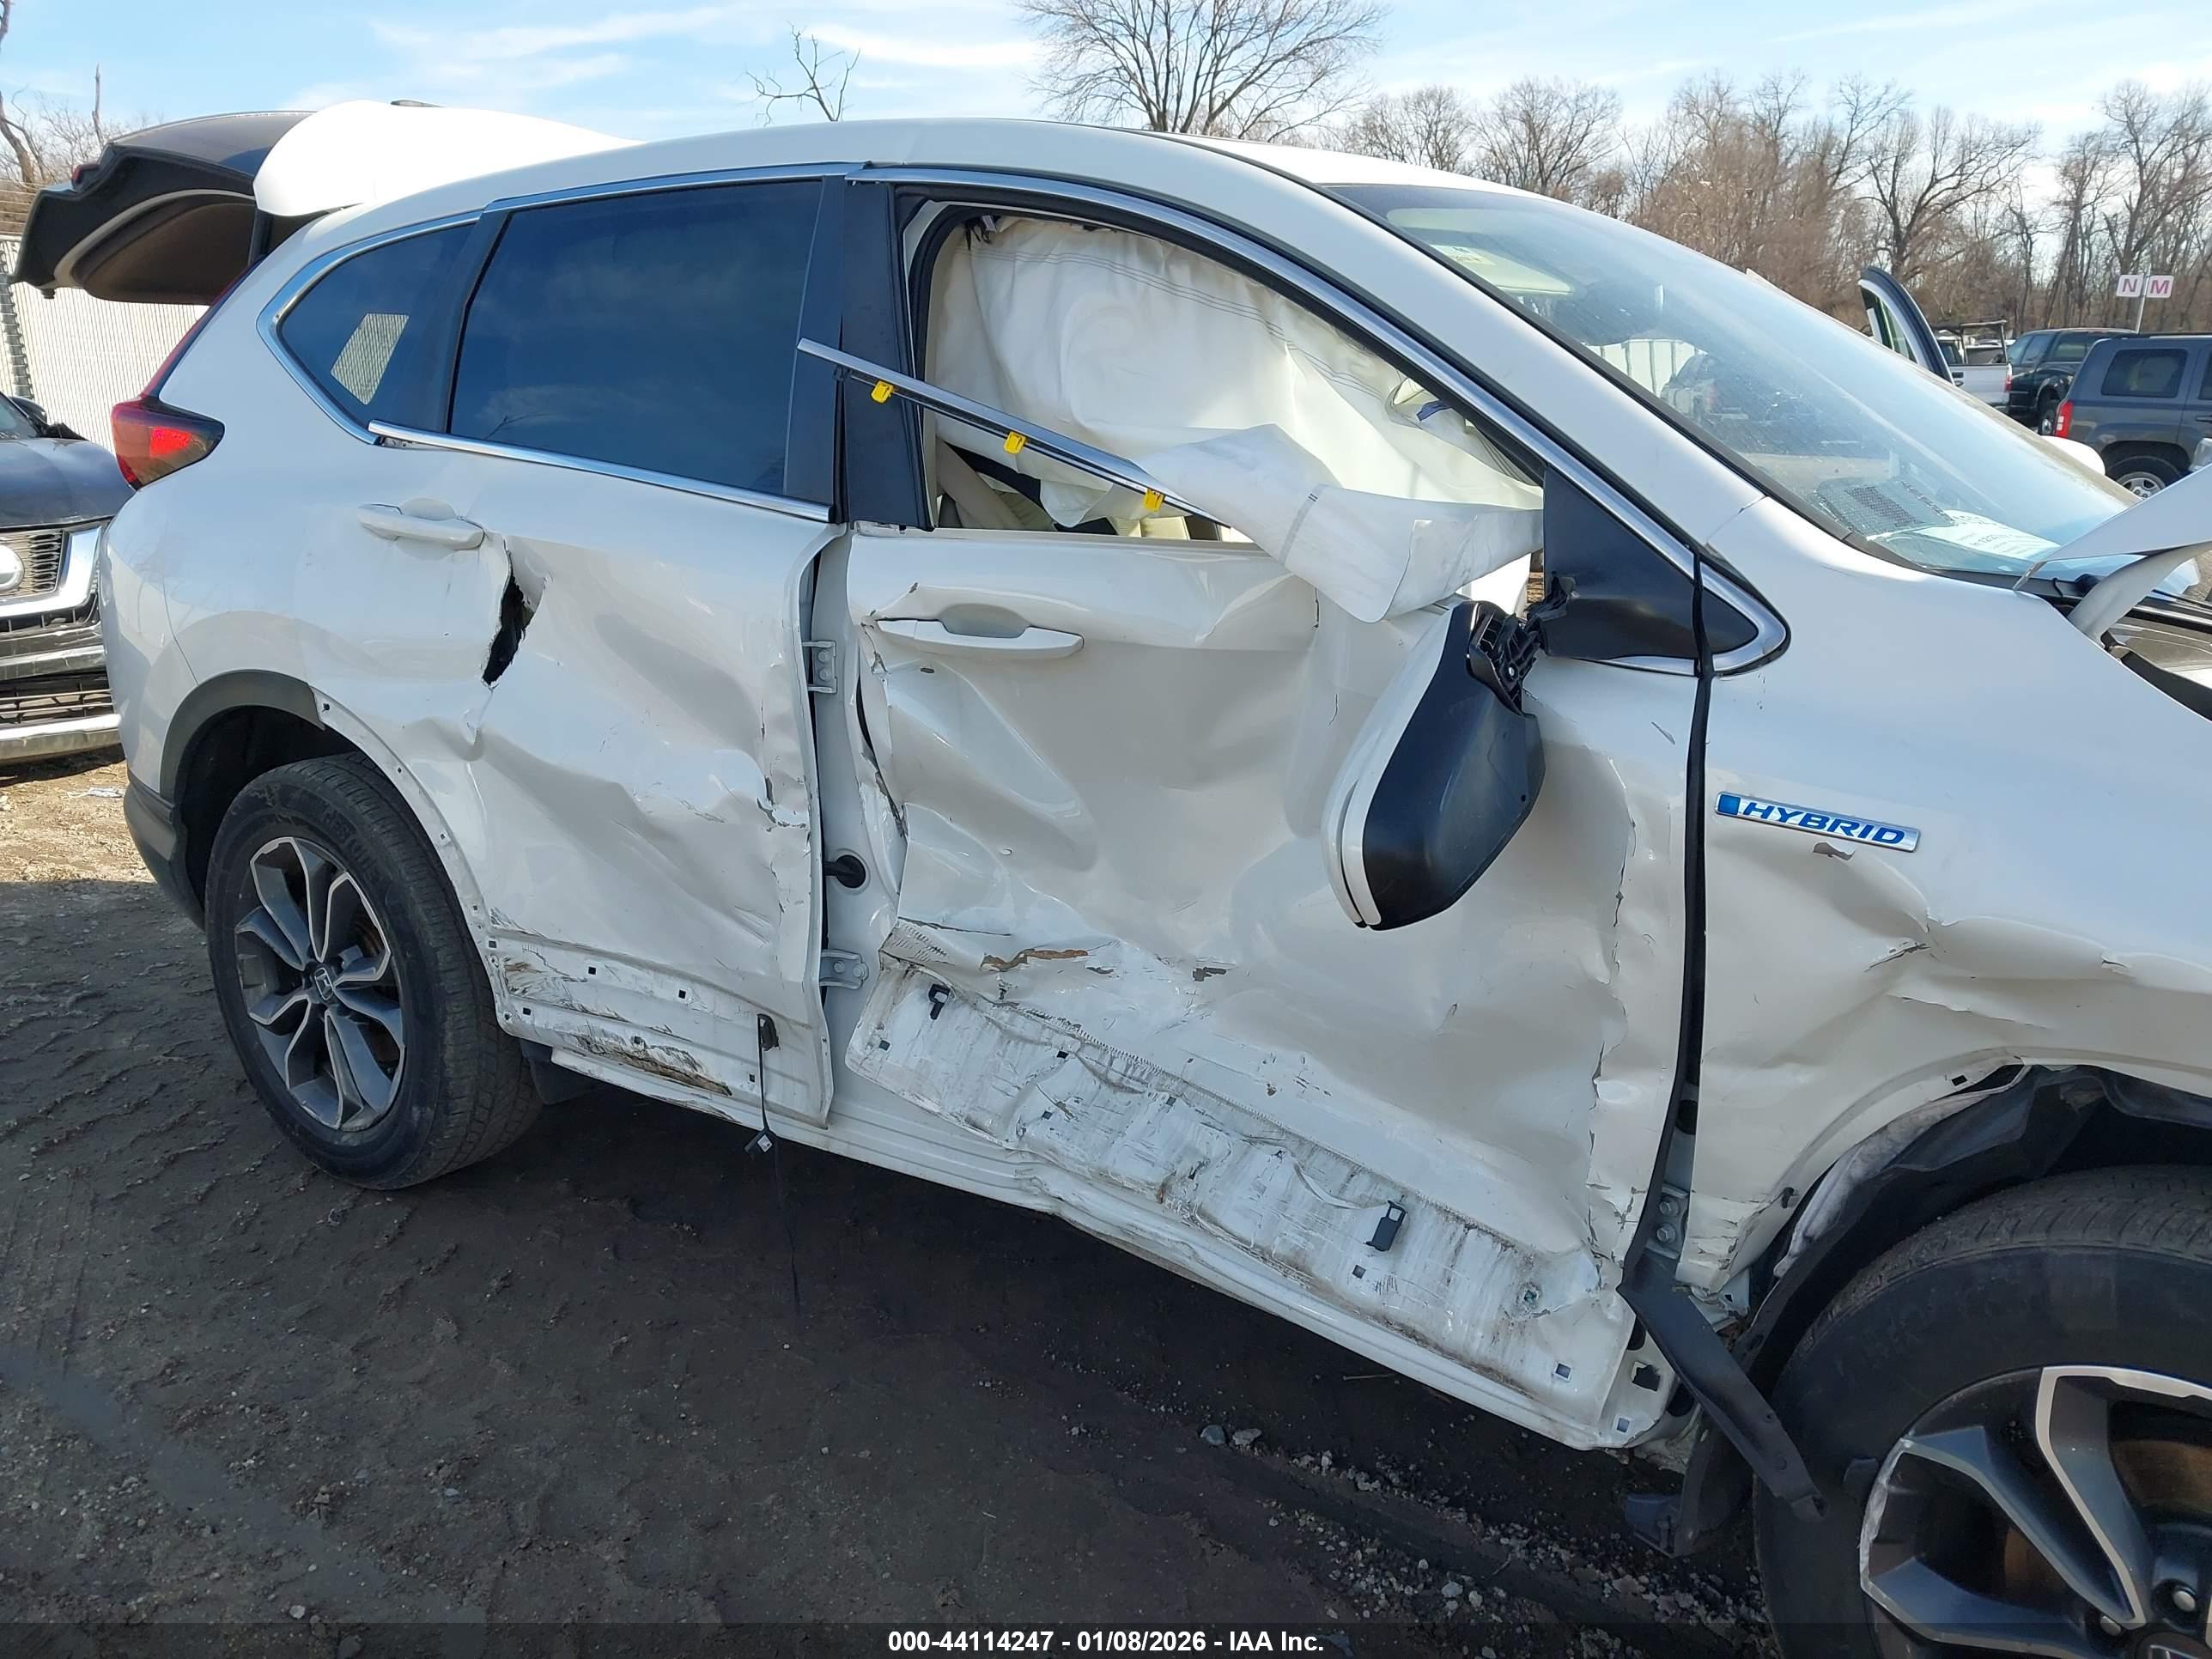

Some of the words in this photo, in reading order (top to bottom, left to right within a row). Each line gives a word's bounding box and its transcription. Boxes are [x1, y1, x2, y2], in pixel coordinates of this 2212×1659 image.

[2122, 278, 2138, 293] N
[2149, 279, 2170, 294] M
[1742, 801, 1905, 845] HYBRID
